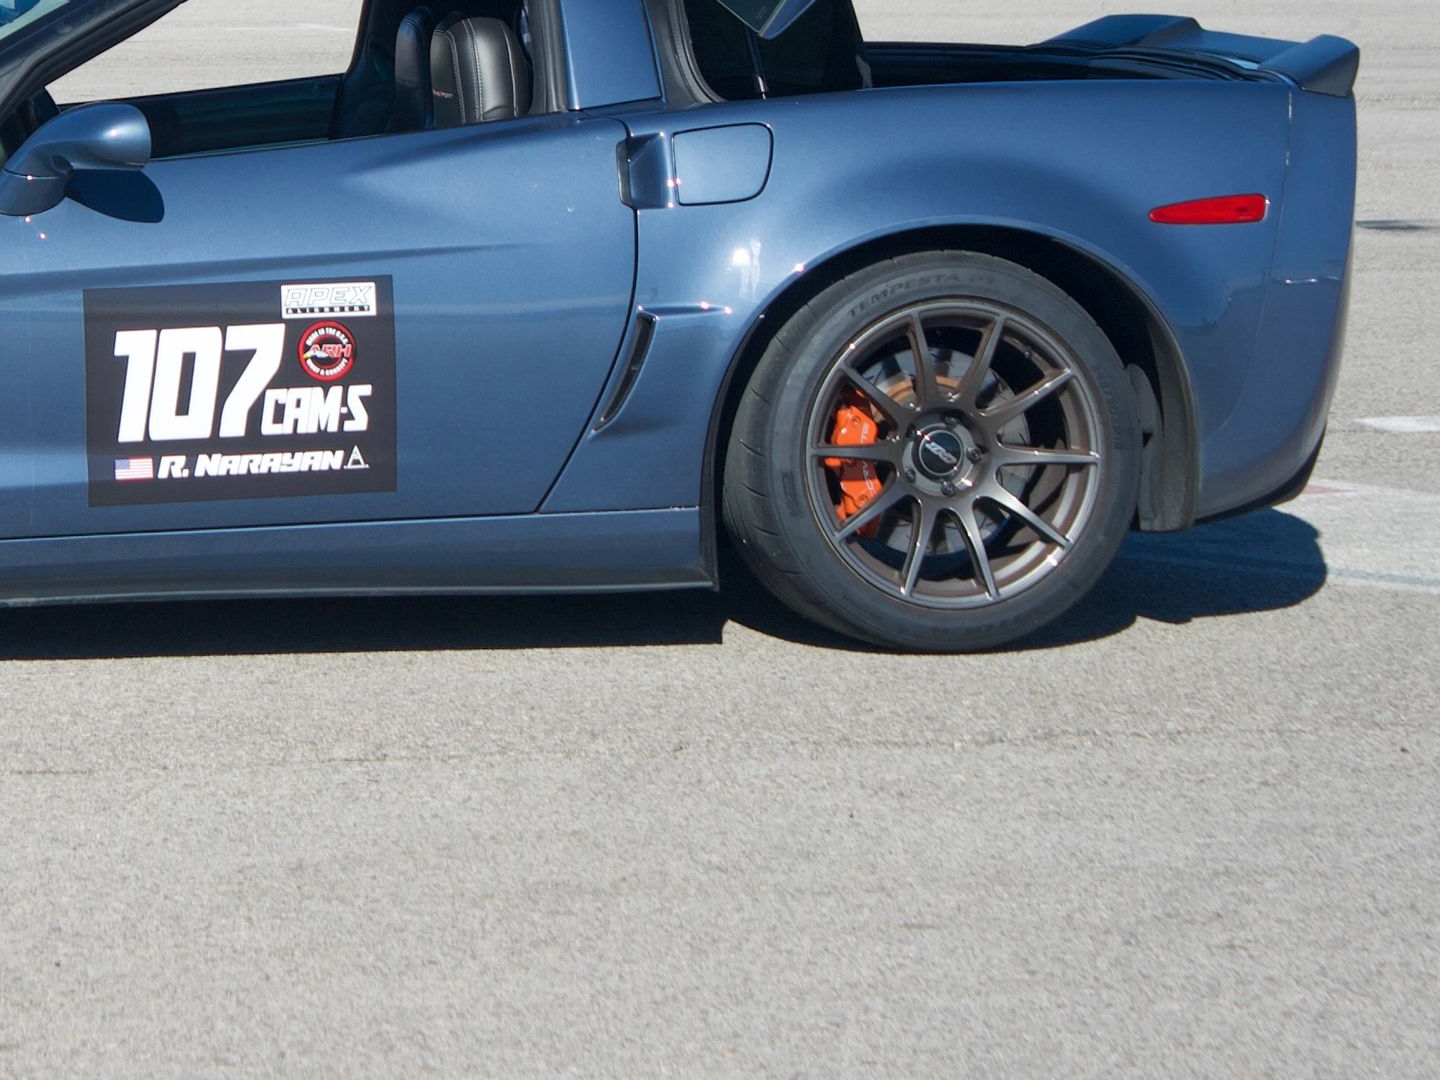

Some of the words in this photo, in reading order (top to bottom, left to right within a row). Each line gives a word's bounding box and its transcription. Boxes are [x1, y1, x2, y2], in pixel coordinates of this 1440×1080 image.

[284, 284, 372, 307] APEX
[114, 323, 286, 443] 107
[260, 384, 372, 436] CAM-S
[157, 455, 189, 479] R.
